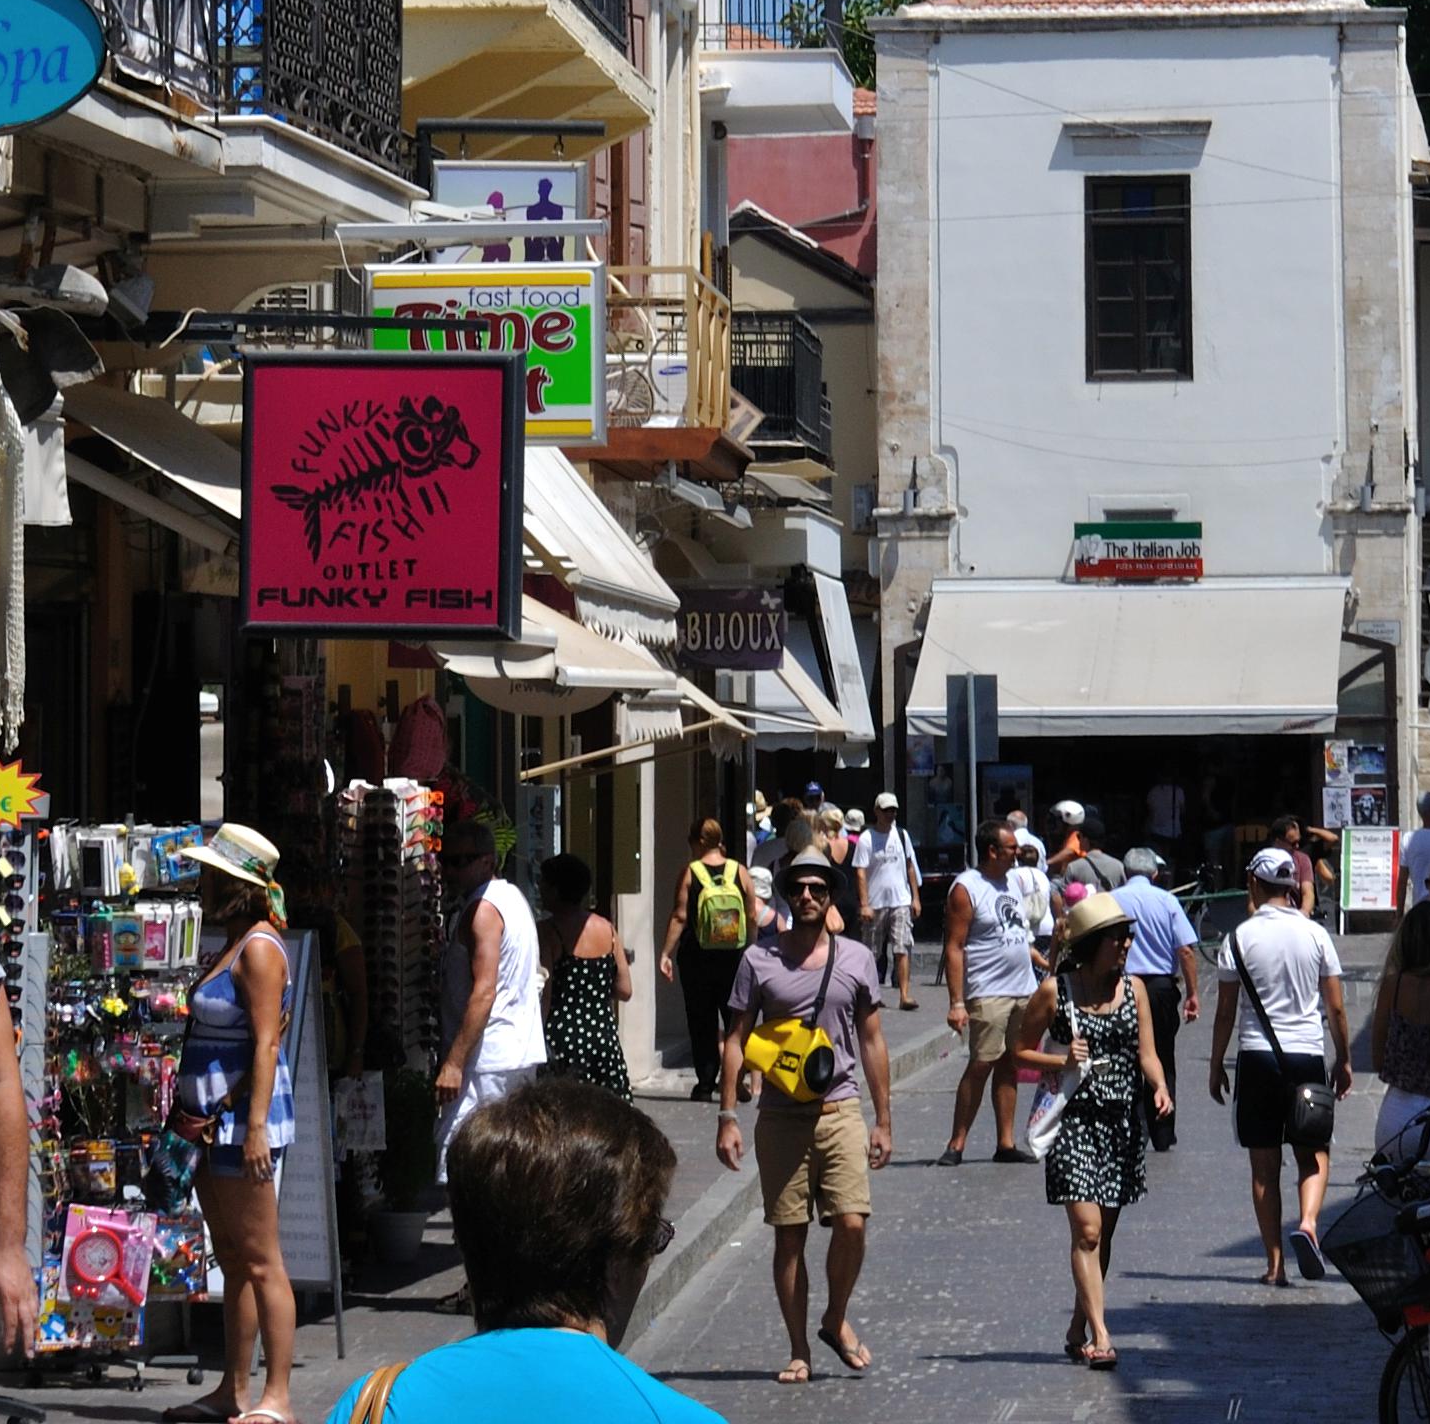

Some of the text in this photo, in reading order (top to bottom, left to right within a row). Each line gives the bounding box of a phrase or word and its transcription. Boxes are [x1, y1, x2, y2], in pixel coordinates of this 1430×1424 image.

[469, 286, 580, 307] fast food
[393, 299, 575, 352] Time
[291, 399, 388, 475] FUNKY
[328, 506, 425, 556] FISH
[1104, 541, 1201, 558] The Italian Job
[323, 558, 418, 581] OUTLET
[257, 587, 493, 609] FUNKY FISH
[685, 611, 782, 652] BIJOUX
